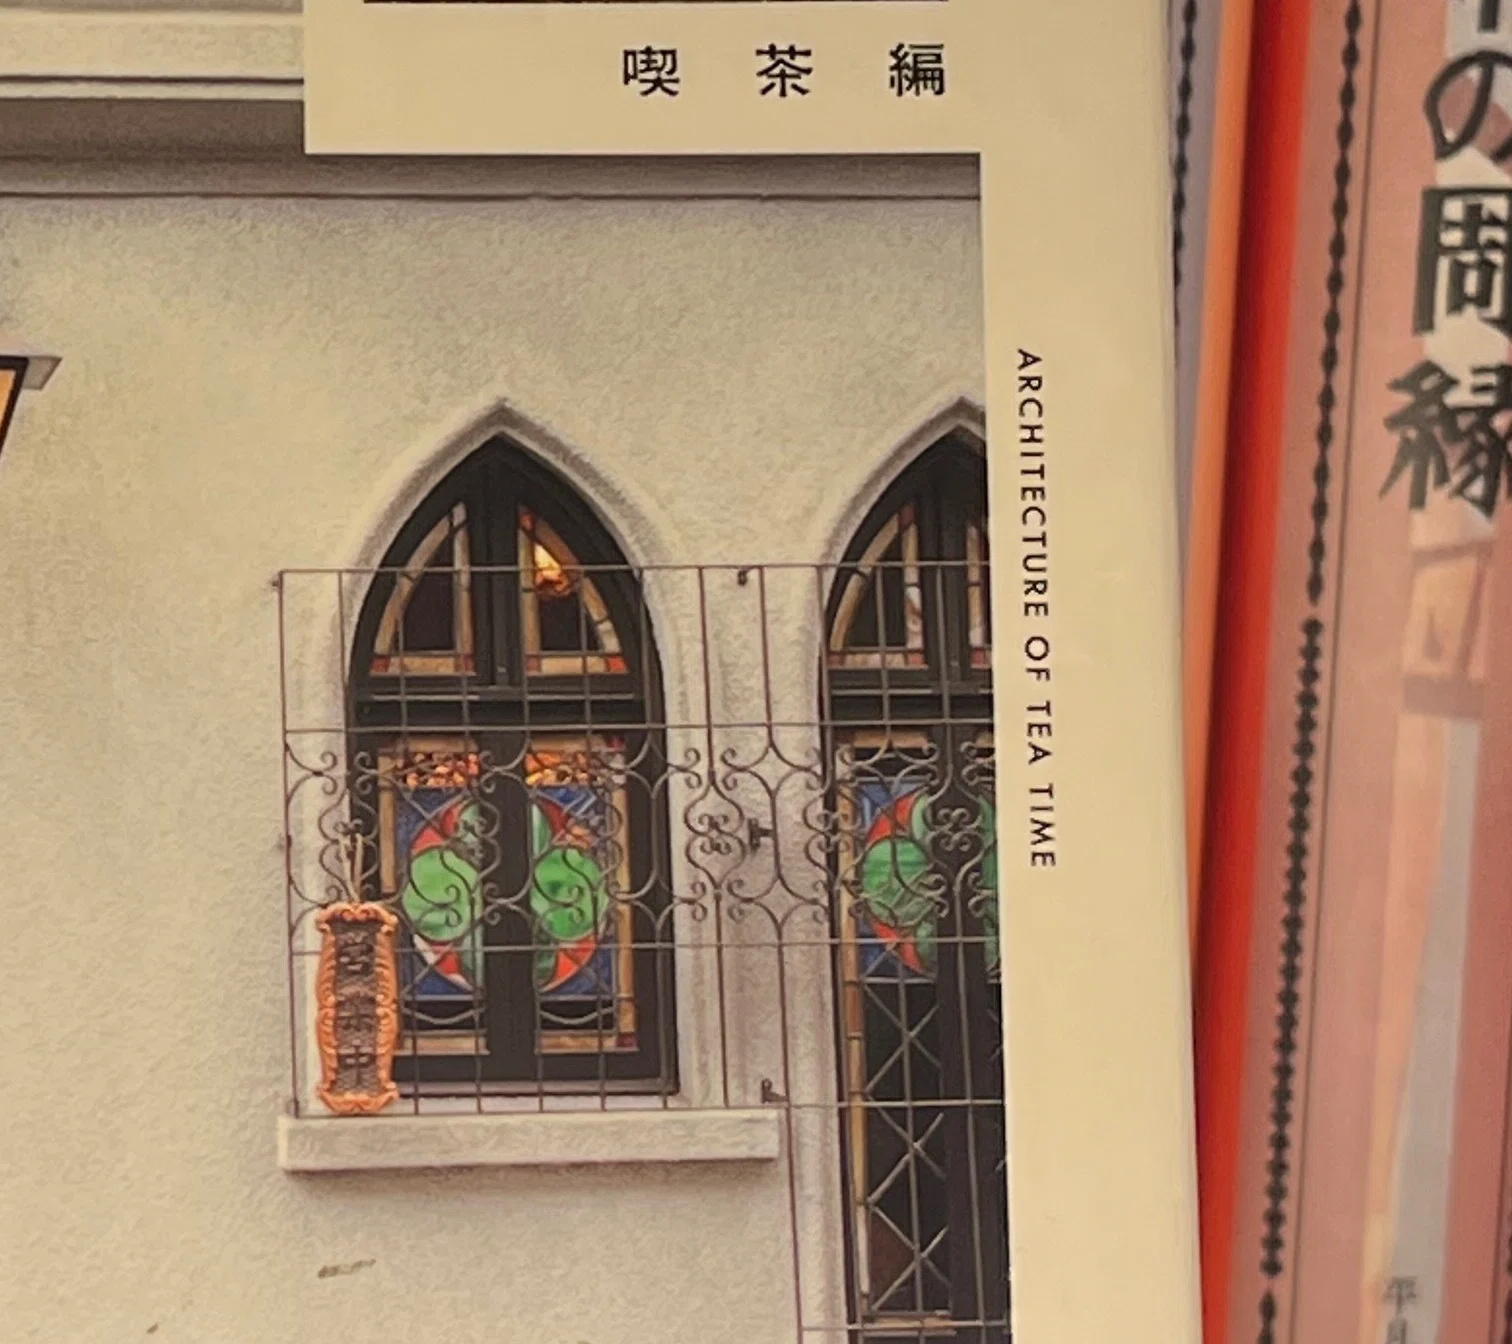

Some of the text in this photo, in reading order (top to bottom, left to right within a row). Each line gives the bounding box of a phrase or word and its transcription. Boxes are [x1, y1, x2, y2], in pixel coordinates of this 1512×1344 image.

[1017, 348, 1057, 867] ARCHITECTURE OF TEA TIME
